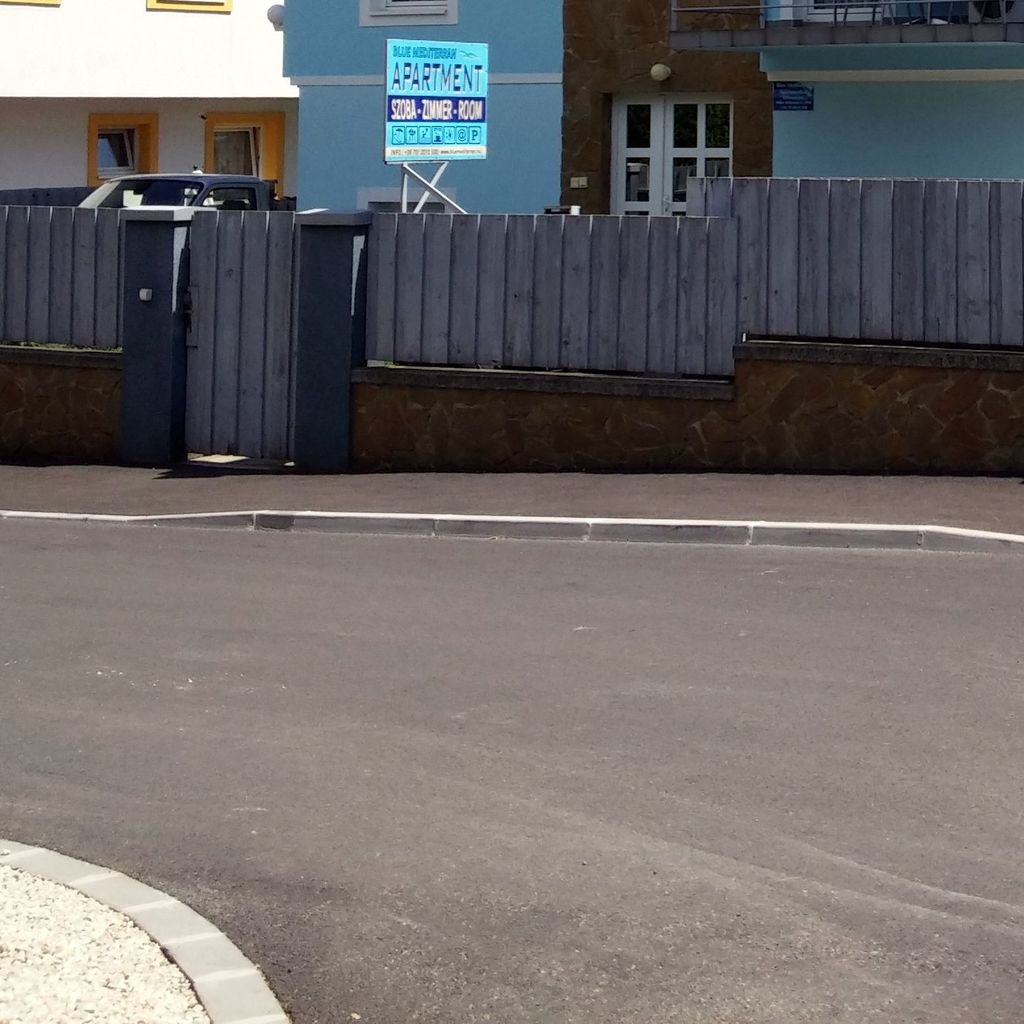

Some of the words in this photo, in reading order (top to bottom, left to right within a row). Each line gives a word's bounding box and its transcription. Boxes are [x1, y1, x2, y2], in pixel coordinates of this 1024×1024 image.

[393, 46, 412, 58] BLUE
[412, 47, 457, 59] MEDITERRAN
[391, 62, 483, 92] APARTMENT
[391, 98, 417, 120] SZOBA
[422, 99, 453, 120] ZIMMER
[458, 99, 483, 120] ROOM
